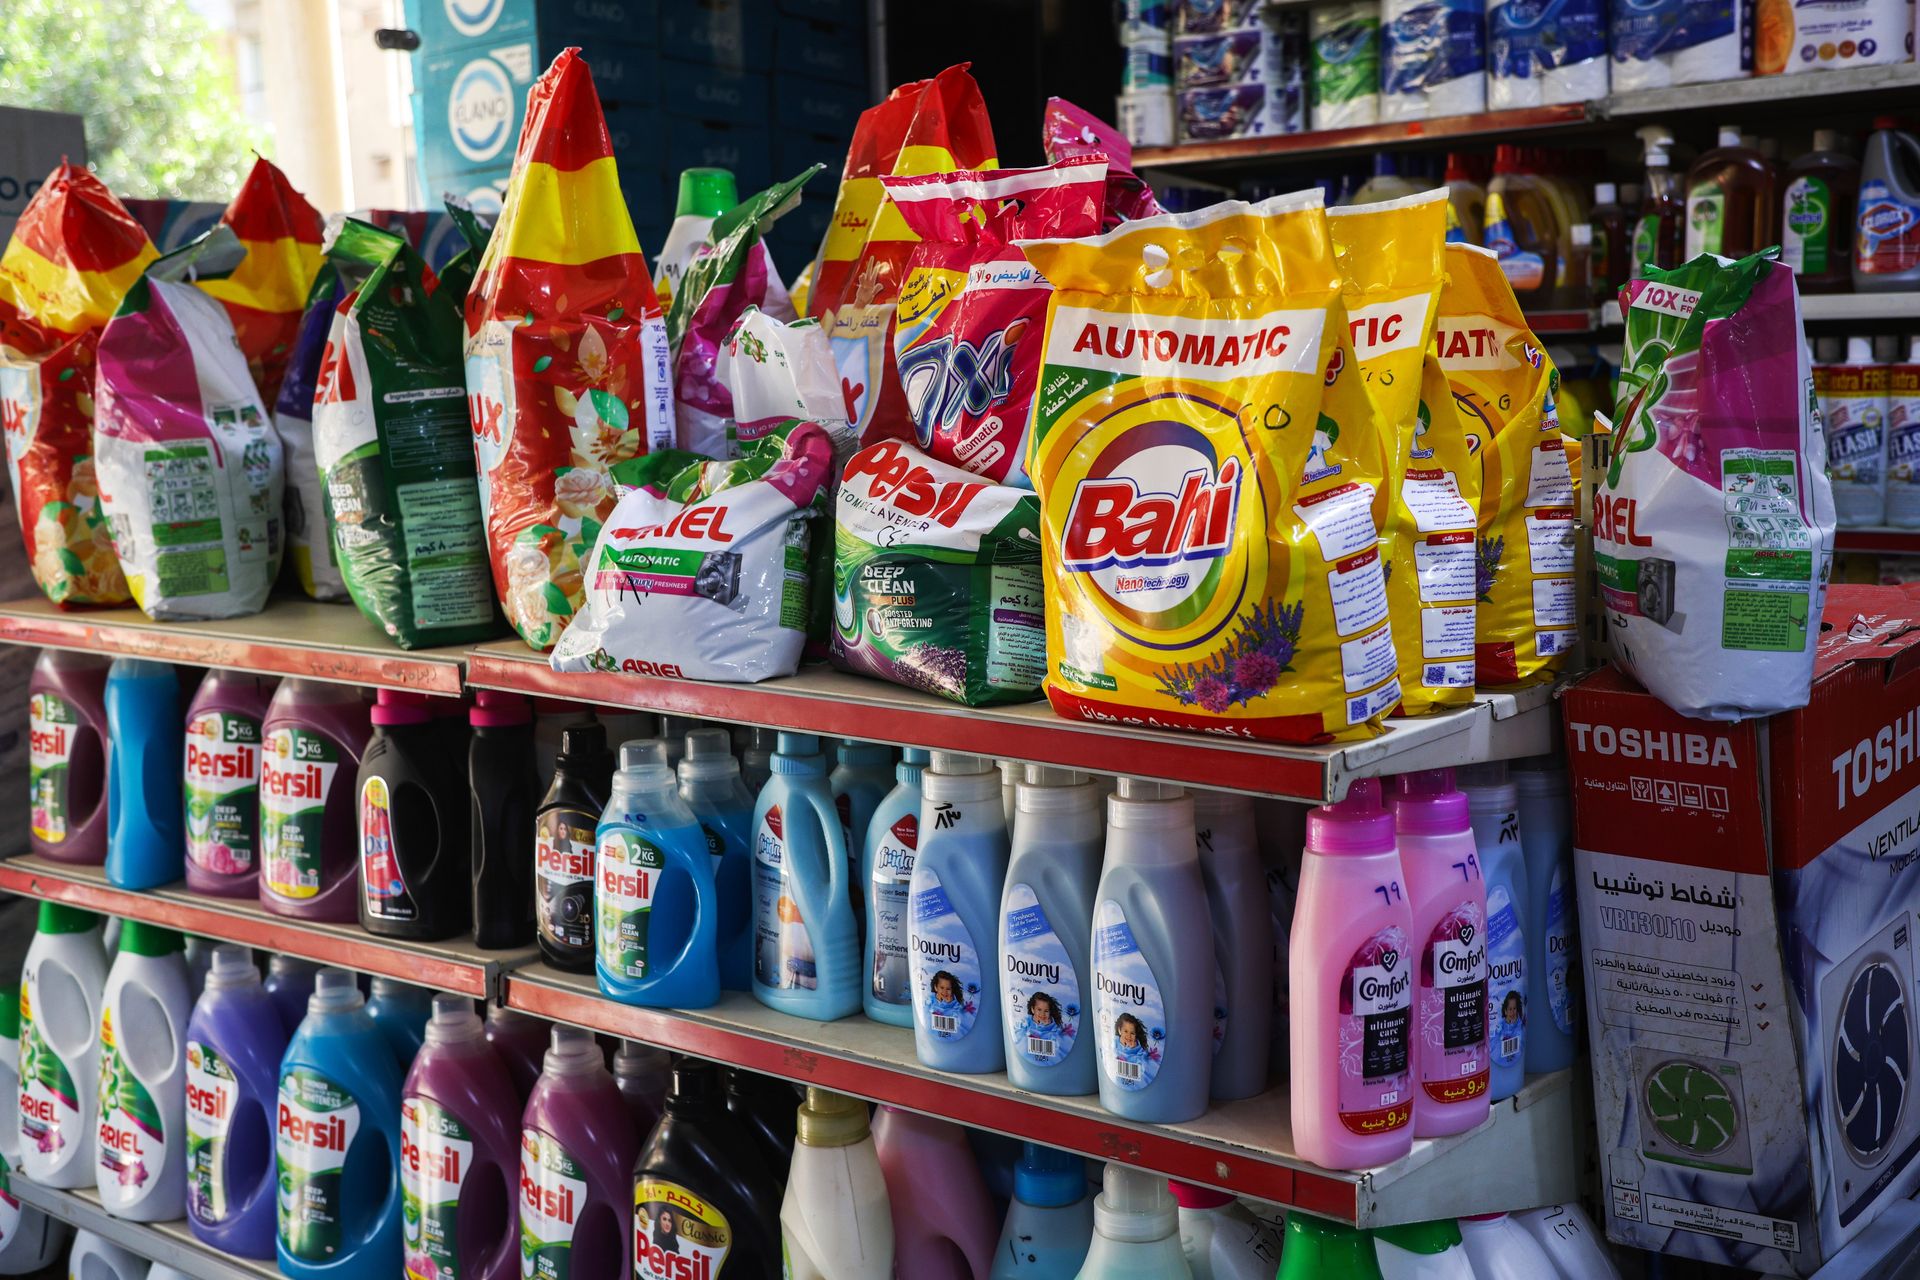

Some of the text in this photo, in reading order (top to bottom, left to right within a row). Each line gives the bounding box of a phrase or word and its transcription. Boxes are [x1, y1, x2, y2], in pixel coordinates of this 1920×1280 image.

[1645, 287, 1680, 311] 10X
[1072, 321, 1291, 368] AUTOMATIC
[956, 420, 999, 458] Automatic
[1063, 457, 1238, 568] Bahi
[617, 553, 680, 567] AUTOMATIC
[864, 565, 905, 579] DEEP
[867, 580, 916, 594] CLEAN
[891, 596, 915, 605] PLUS
[31, 726, 66, 757] ersil
[226, 720, 238, 740] 5
[296, 737, 308, 758] 5
[1570, 721, 1738, 769] TOSHIBA
[1832, 704, 1920, 811] TOSHI
[187, 743, 254, 780] Persil
[262, 761, 322, 800] Persil
[537, 843, 595, 878] Persil
[631, 843, 655, 865] 2 KG
[597, 861, 649, 900] Persil
[1593, 871, 1738, 910] شفاط توشيبا
[1599, 904, 1742, 943] موديل VRH30J10
[912, 934, 961, 964] Downy
[1439, 947, 1485, 975] Comfort
[1007, 954, 1060, 985] Downy
[1628, 961, 1660, 975] الشفط
[1710, 976, 1736, 988] مزود
[1097, 972, 1145, 1006] Downy
[1359, 970, 1410, 1001] Comfort
[1450, 989, 1482, 1003] ultimate
[1458, 999, 1477, 1010] care
[1635, 1000, 1672, 1016] المطبخ
[1370, 1018, 1405, 1031] ultimate
[1379, 1027, 1399, 1038] care
[1693, 1011, 1741, 1028] يستخدم
[1444, 1087, 1467, 1097] جنيه
[1468, 1080, 1476, 1095] 9
[20, 1093, 60, 1123] ARIEL
[1388, 1111, 1397, 1127] 9
[279, 1102, 346, 1152] Persil
[1362, 1118, 1386, 1130] جنيه
[100, 1123, 144, 1155] ARIEL
[402, 1130, 460, 1184] Persil
[521, 1164, 574, 1225] Persil
[666, 1190, 703, 1216] خصم
[681, 1217, 726, 1244] Classic
[636, 1229, 713, 1280] Persil
